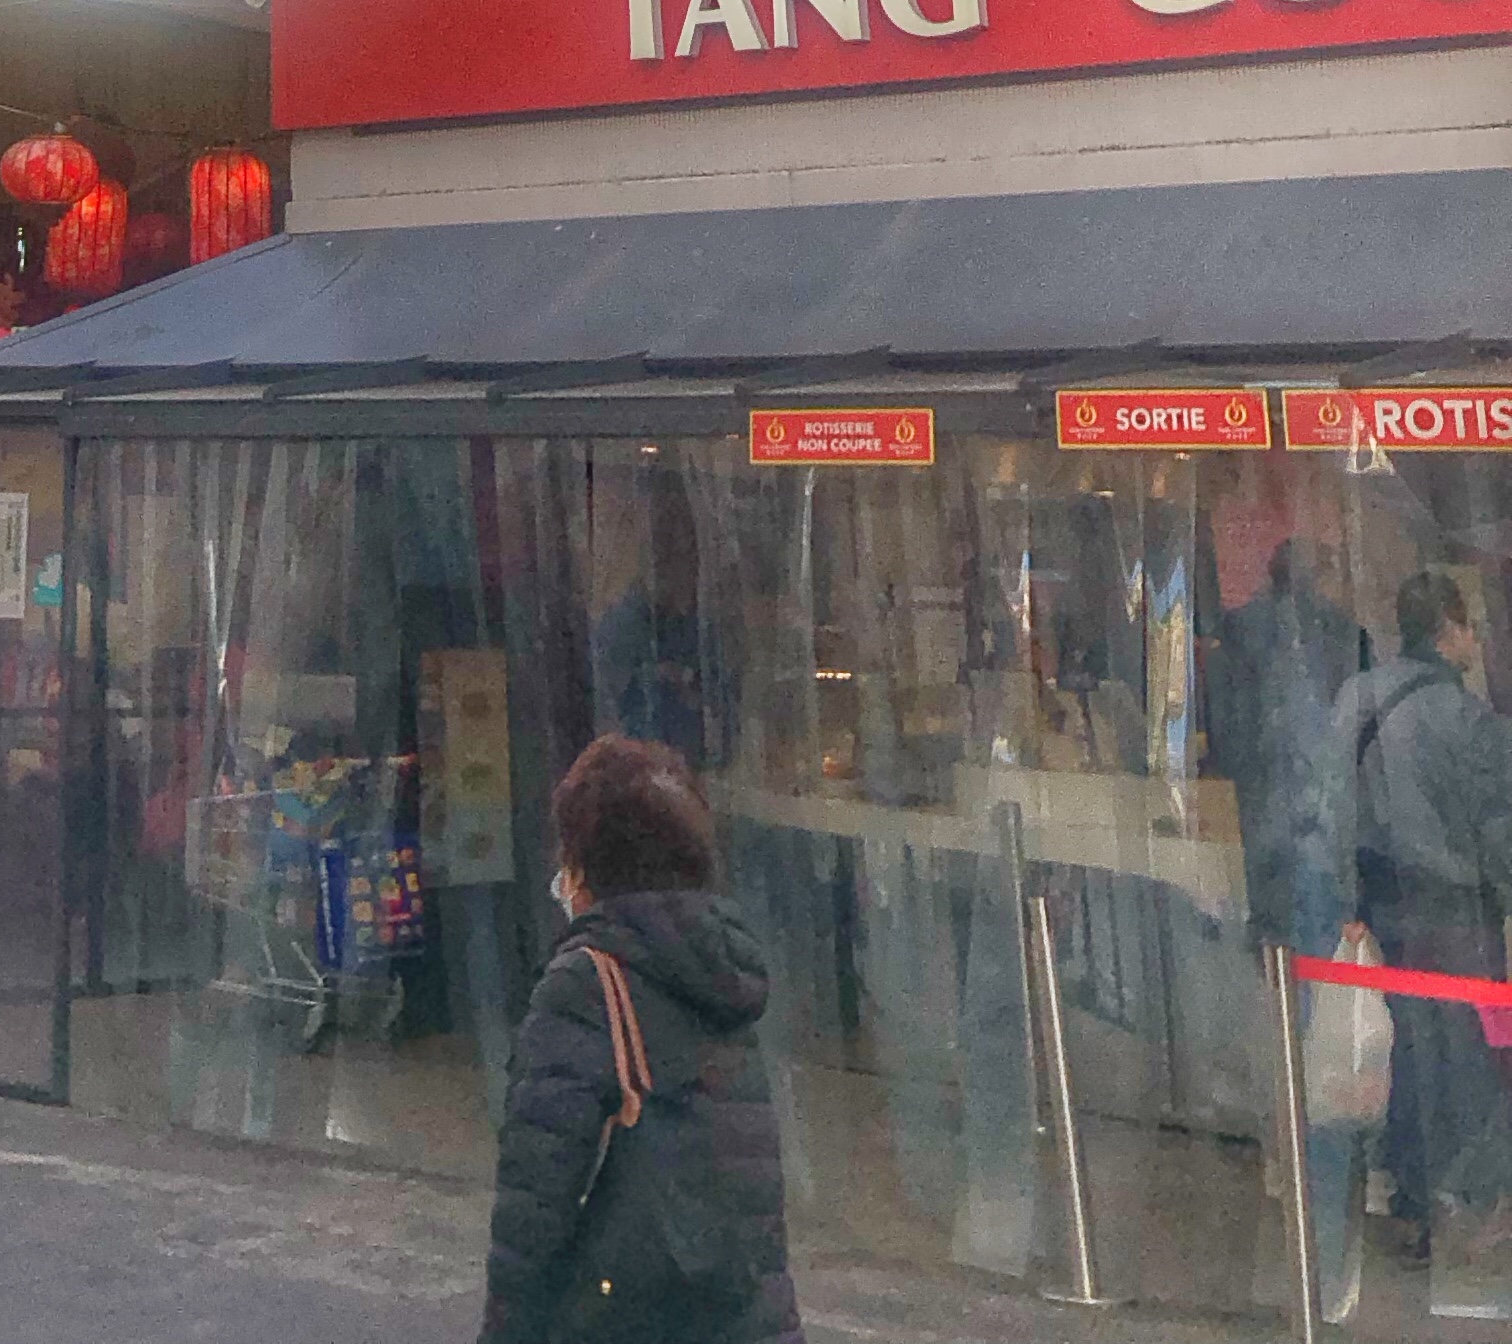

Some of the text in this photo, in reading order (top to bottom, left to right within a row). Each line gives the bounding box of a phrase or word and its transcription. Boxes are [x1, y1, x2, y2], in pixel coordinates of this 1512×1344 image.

[804, 421, 875, 436] ROTISSERIE
[1115, 407, 1207, 432] SORTIE
[1373, 398, 1512, 440] ROTIS
[797, 438, 828, 452] NON
